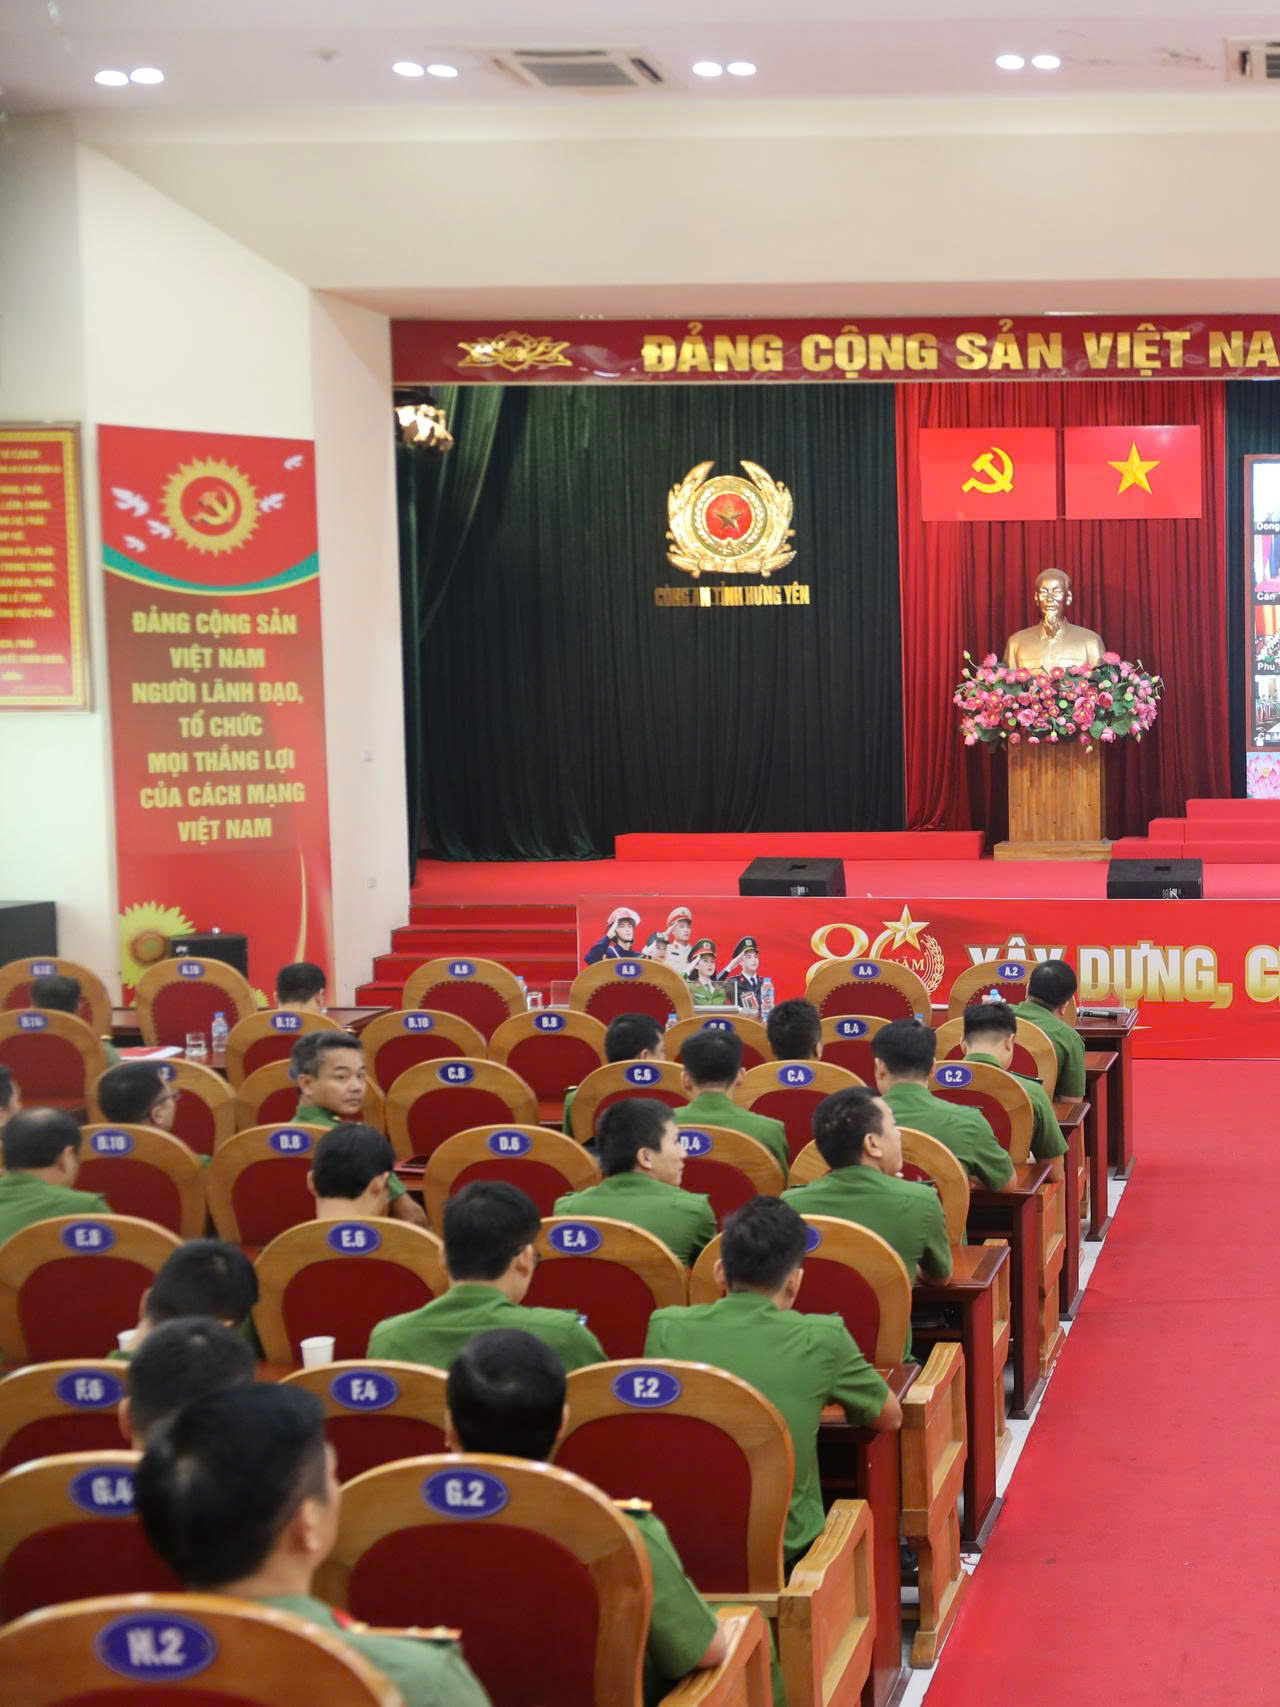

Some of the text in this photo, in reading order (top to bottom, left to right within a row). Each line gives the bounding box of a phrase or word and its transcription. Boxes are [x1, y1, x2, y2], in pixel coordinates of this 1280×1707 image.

[642, 322, 783, 372] ĐẢNG
[800, 325, 939, 378] CỘNG
[956, 319, 1063, 370] SẢN
[1083, 323, 1191, 376] VIỆT
[1256, 522, 1280, 531] Dong
[745, 584, 782, 605] HƯNG
[783, 581, 810, 605] YÊN
[1257, 592, 1276, 600] Can
[132, 605, 297, 638] ĐẢNG CỘNG SẢN
[169, 647, 266, 672] VIỆT NAM
[1258, 662, 1275, 671] Phu
[132, 680, 304, 707] NGƯỜI LÃNH ĐẠO,
[179, 710, 262, 738] TỔ CHỨC
[1258, 732, 1271, 740] Ca
[147, 744, 294, 777] MỌI THẮNG LỢI
[140, 781, 305, 808] CỦA CÁCH MẠNG
[178, 817, 272, 845] VIỆT NAM
[622, 966, 635, 976] A.6
[859, 966, 872, 976] A.4
[1005, 967, 1018, 976] A.2
[1077, 940, 1234, 1009] DỰNG,
[276, 1018, 296, 1028] B.12
[408, 1018, 428, 1028] B.10
[542, 1017, 557, 1028] B.8
[844, 1023, 859, 1034] B.4
[448, 1068, 465, 1080] C.8
[634, 1069, 651, 1081] C.6
[787, 1070, 804, 1082] C.4
[945, 1070, 962, 1082] C.2
[280, 1135, 300, 1149] D.8
[499, 1138, 519, 1150] D.6
[680, 1136, 700, 1150] D.4
[342, 1230, 366, 1247] E.6
[562, 1230, 586, 1248] E.4
[350, 1379, 378, 1399] F.4
[633, 1379, 659, 1398] F.2
[92, 1478, 133, 1504] G.4
[445, 1480, 485, 1506] G.2
